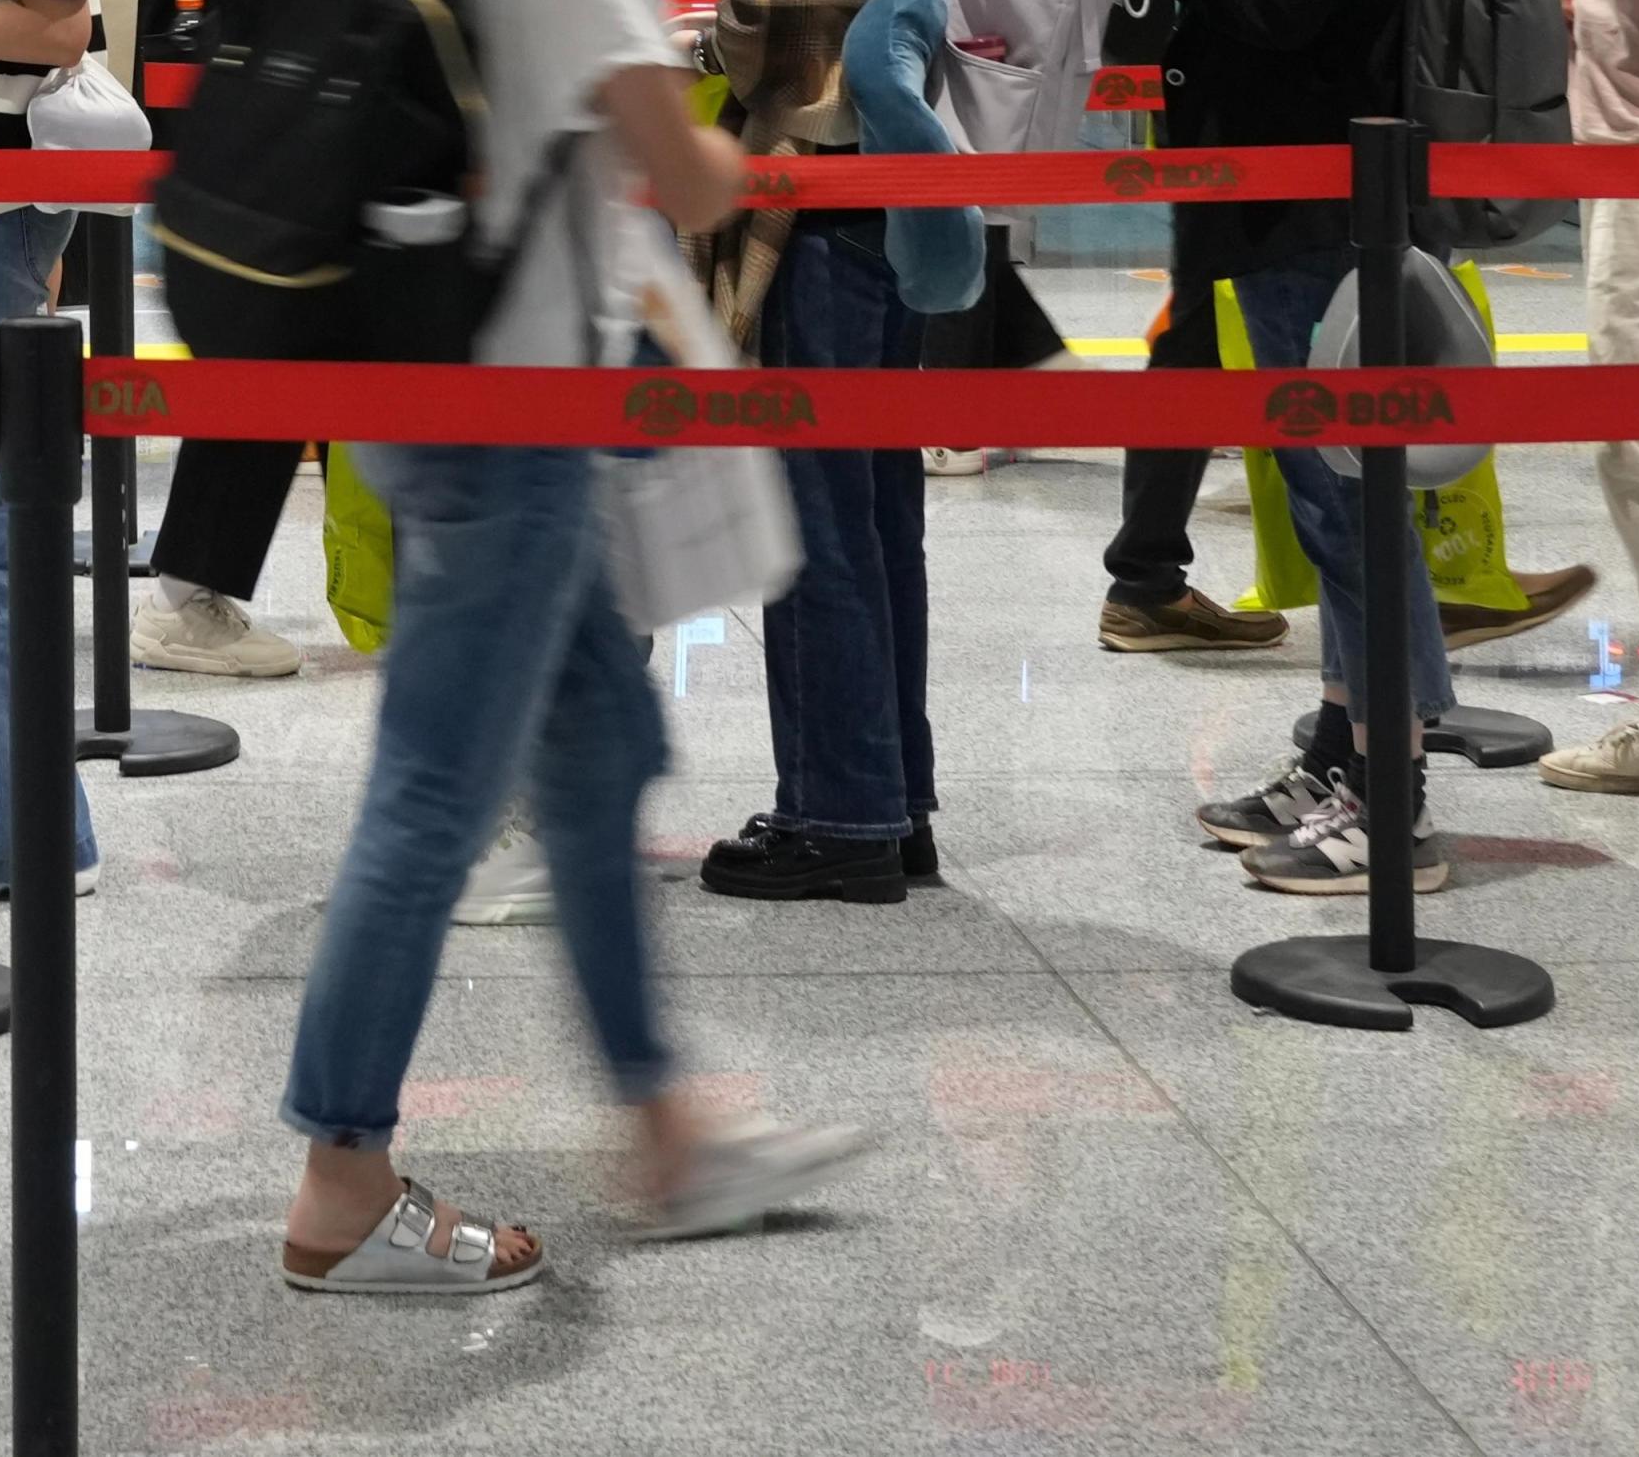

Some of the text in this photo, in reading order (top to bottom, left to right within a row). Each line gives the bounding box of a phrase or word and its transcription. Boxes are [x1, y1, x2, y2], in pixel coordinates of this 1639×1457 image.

[88, 381, 168, 416] DIA
[704, 390, 819, 427] BDIA
[1346, 390, 1456, 428] BDIA
